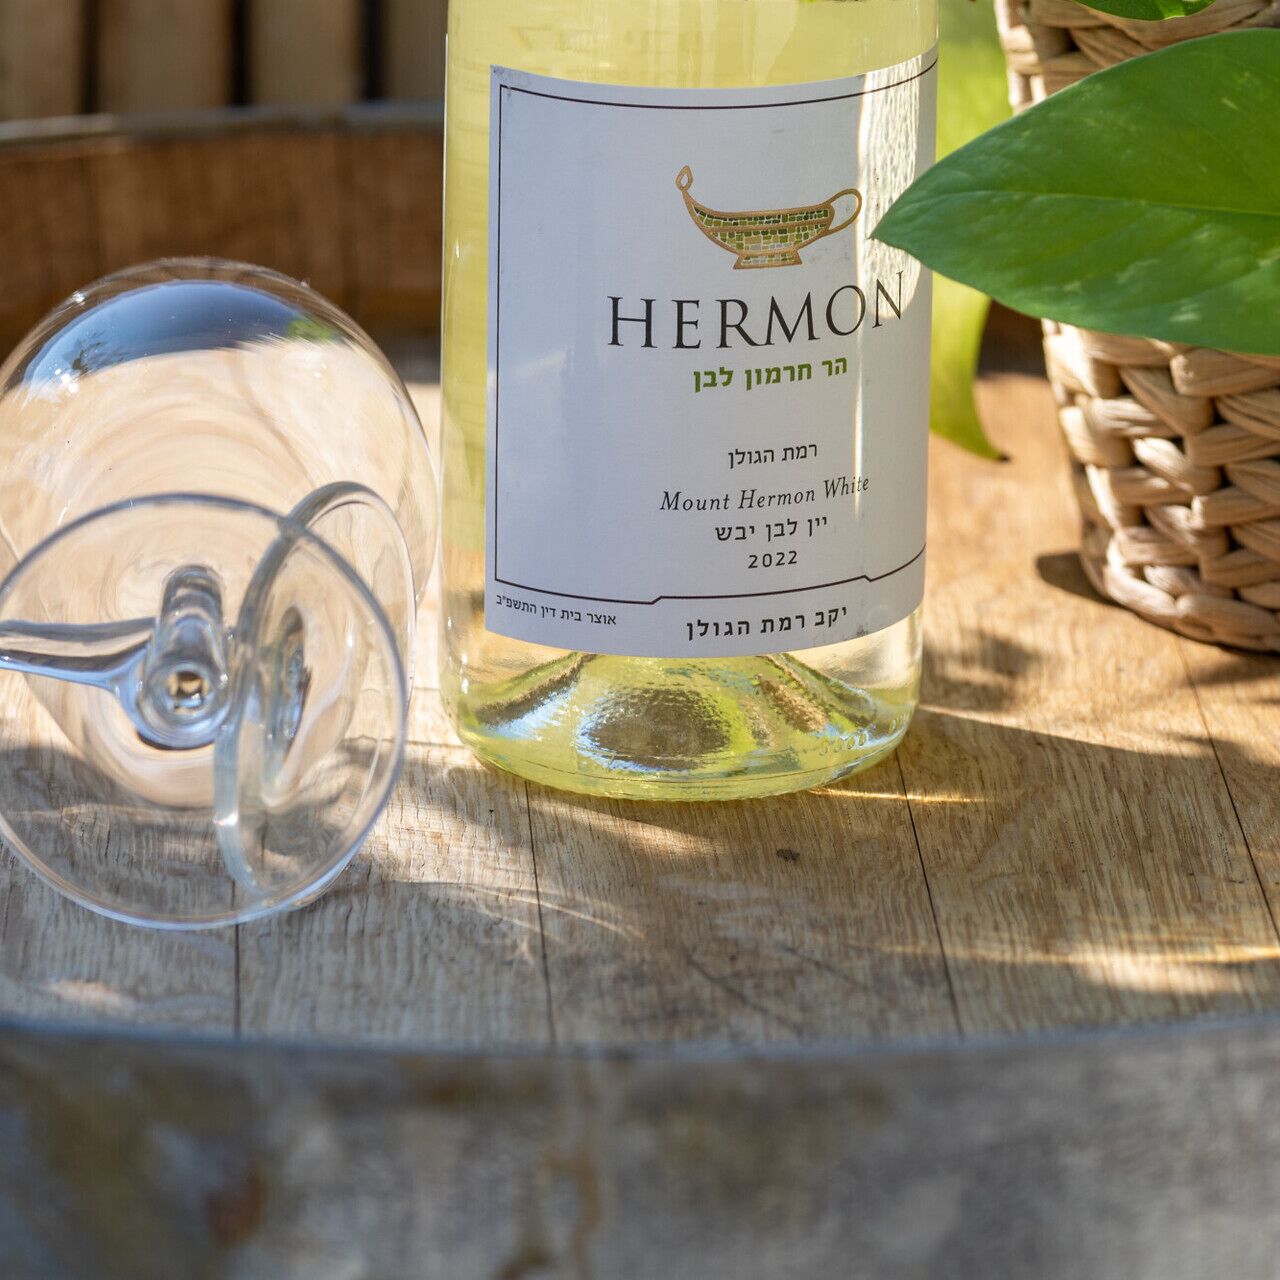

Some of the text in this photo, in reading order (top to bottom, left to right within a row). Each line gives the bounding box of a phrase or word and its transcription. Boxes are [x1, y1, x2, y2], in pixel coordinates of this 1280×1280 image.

[606, 270, 906, 350] HERMON
[692, 356, 849, 394] הר חרמון לבן
[727, 443, 818, 470] רמת הגולן
[659, 475, 870, 512] Mount Hermon White
[714, 516, 829, 543] יין לבן יבש
[747, 550, 799, 569] 2022
[540, 605, 557, 619] דין
[559, 608, 583, 622] בית
[586, 612, 617, 626] אוצר
[685, 605, 848, 642] יקב רמת הגולן
